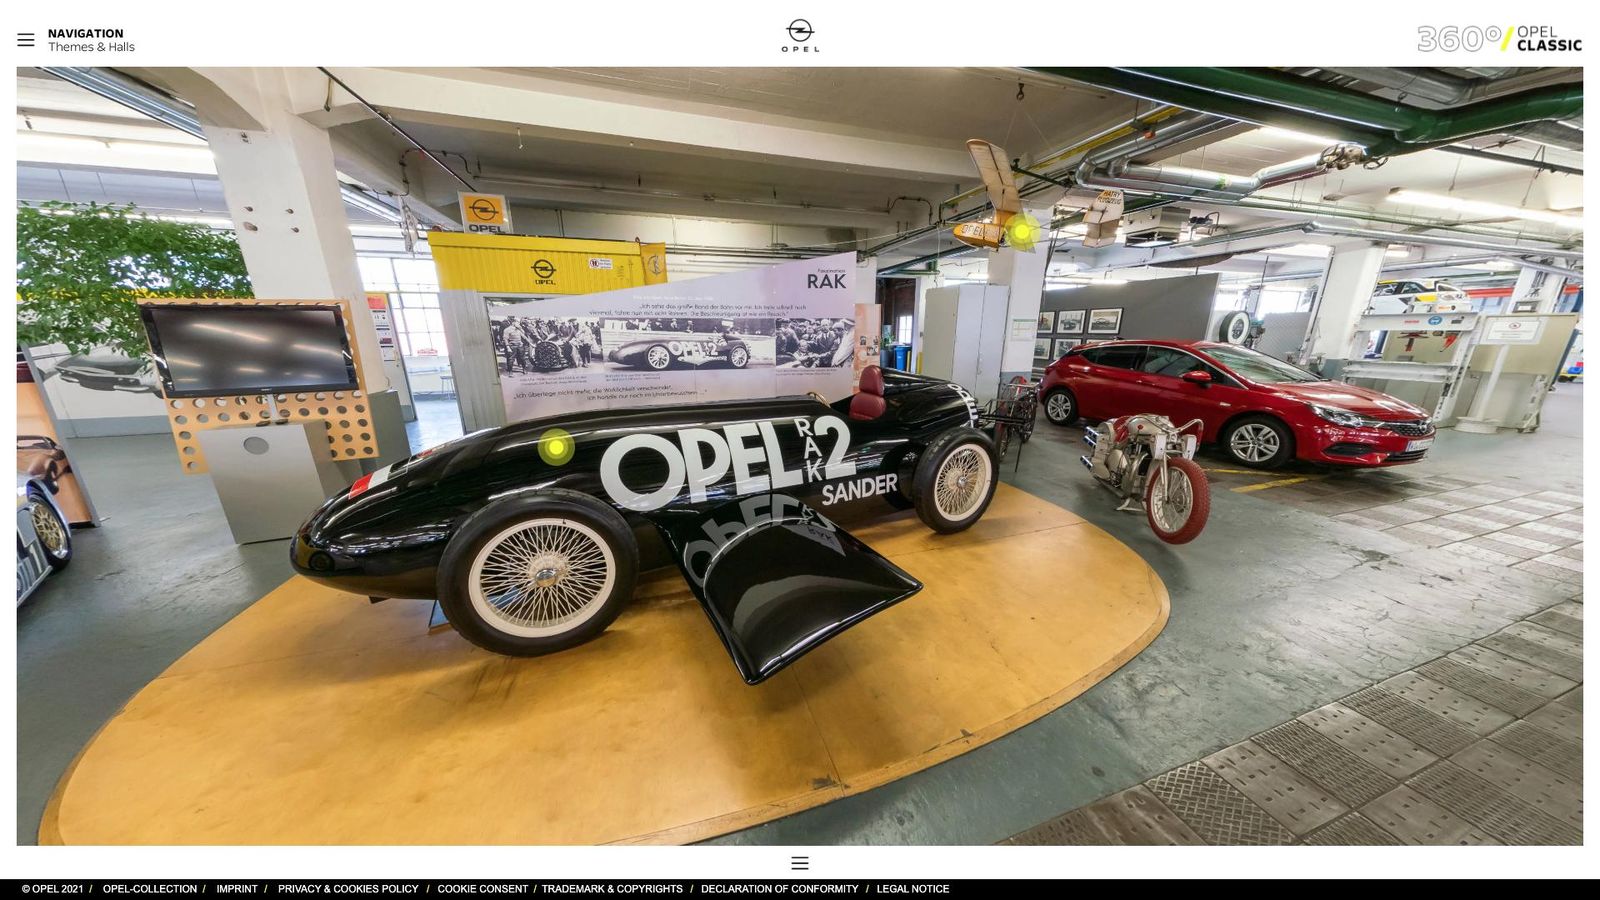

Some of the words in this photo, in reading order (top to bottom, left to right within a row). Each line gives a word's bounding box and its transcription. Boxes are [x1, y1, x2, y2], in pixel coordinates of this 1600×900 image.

[468, 224, 507, 234] OPEL
[807, 274, 847, 289] RAK
[600, 421, 804, 511] OPEL
[793, 418, 823, 483] RAK
[813, 415, 857, 480] 2
[822, 472, 899, 506] SANDER
